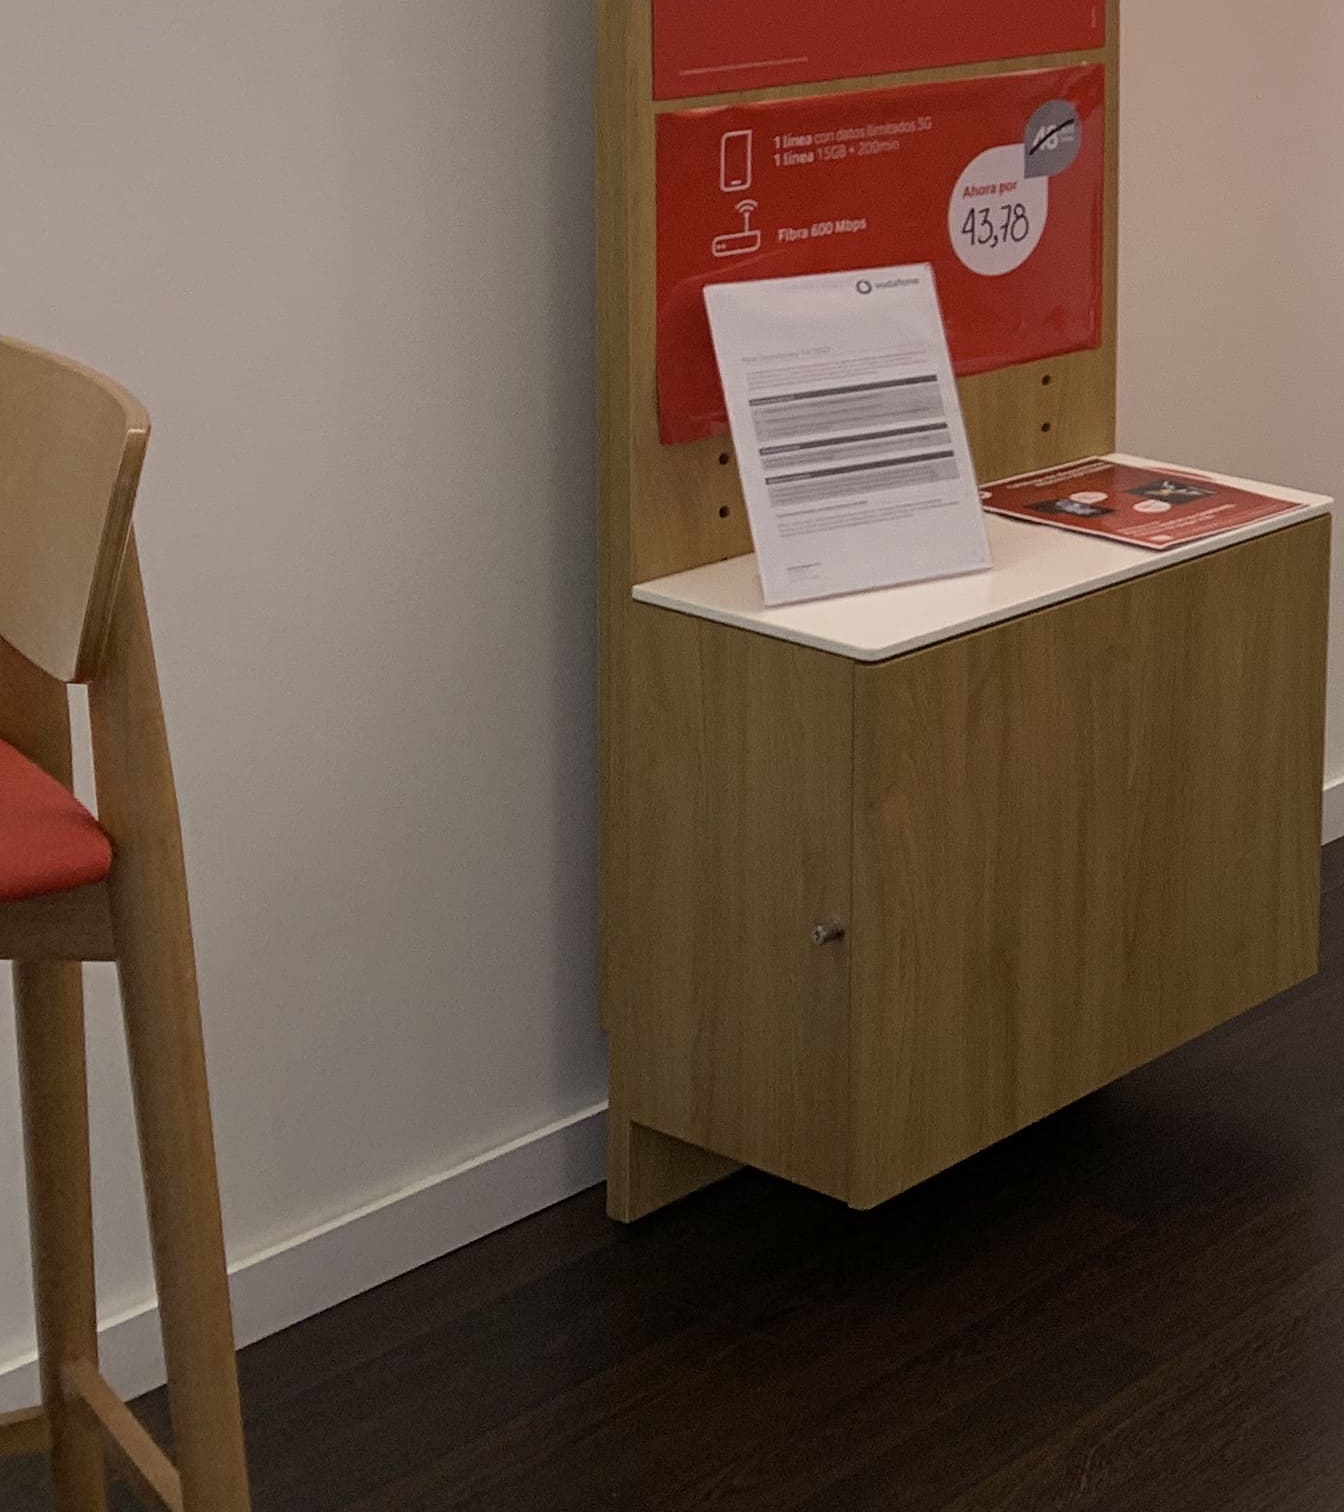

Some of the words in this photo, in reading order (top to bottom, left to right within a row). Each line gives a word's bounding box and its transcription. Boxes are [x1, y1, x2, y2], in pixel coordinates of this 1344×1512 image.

[774, 136, 781, 149] 1
[774, 153, 781, 167] 1
[962, 183, 998, 200] Ahora
[961, 203, 1029, 248] 43,78
[778, 227, 809, 243] Fibra
